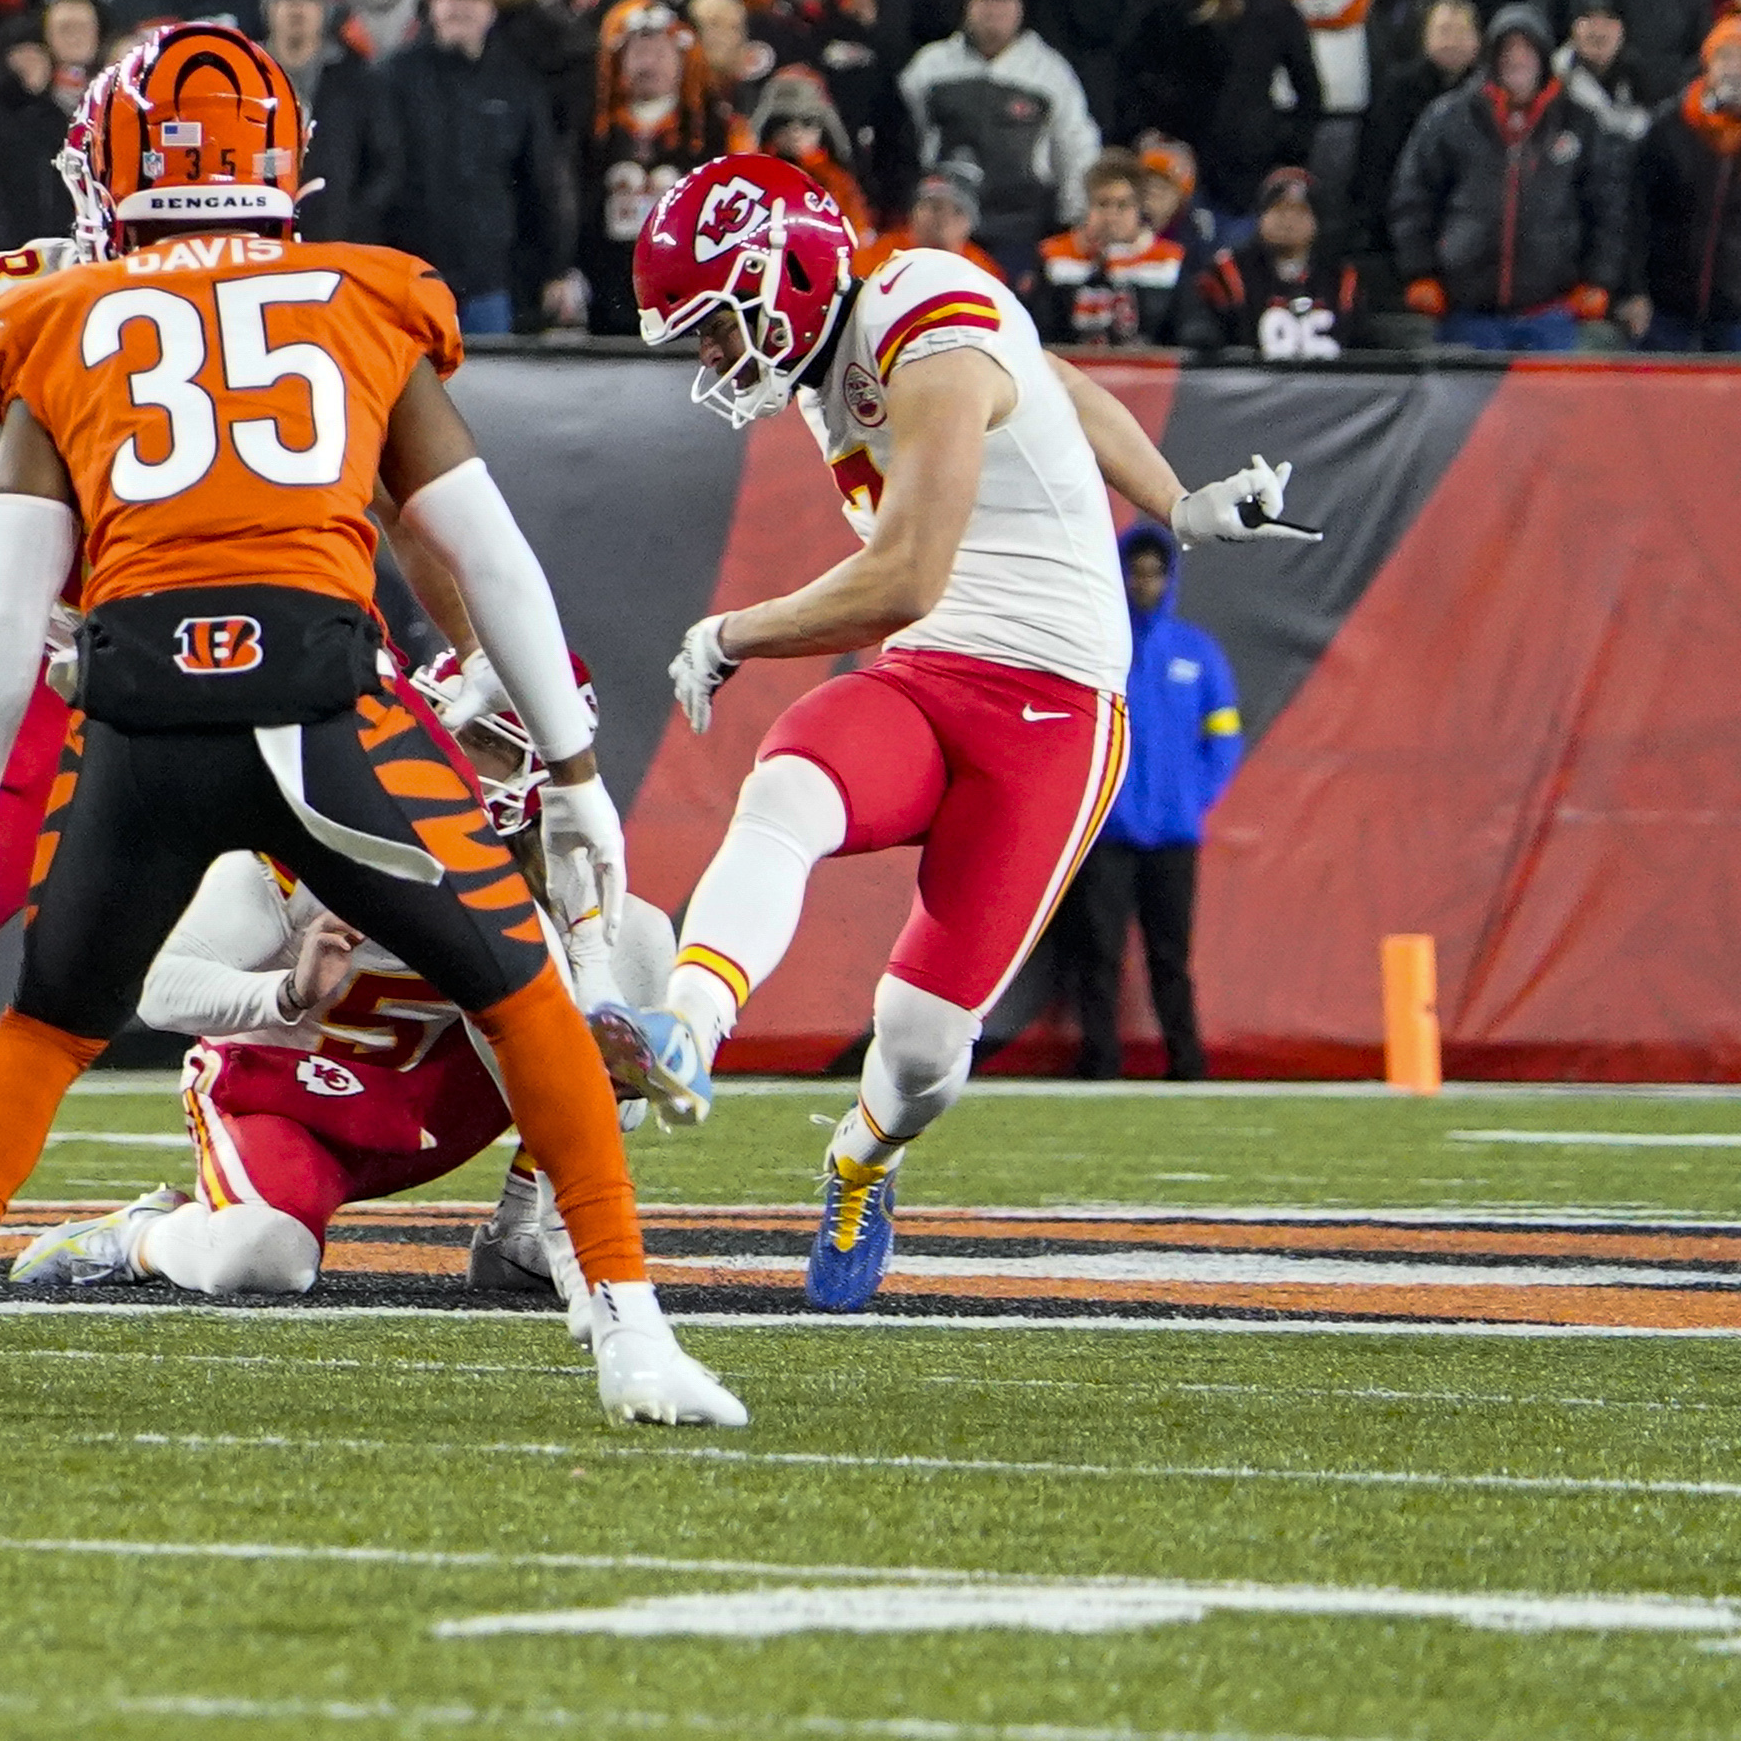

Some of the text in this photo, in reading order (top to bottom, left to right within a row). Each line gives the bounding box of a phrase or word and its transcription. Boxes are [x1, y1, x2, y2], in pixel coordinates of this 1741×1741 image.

[184, 147, 237, 182] 35
[150, 195, 268, 210] BENGALS
[124, 238, 284, 274] DAVIS
[80, 269, 349, 505] 35
